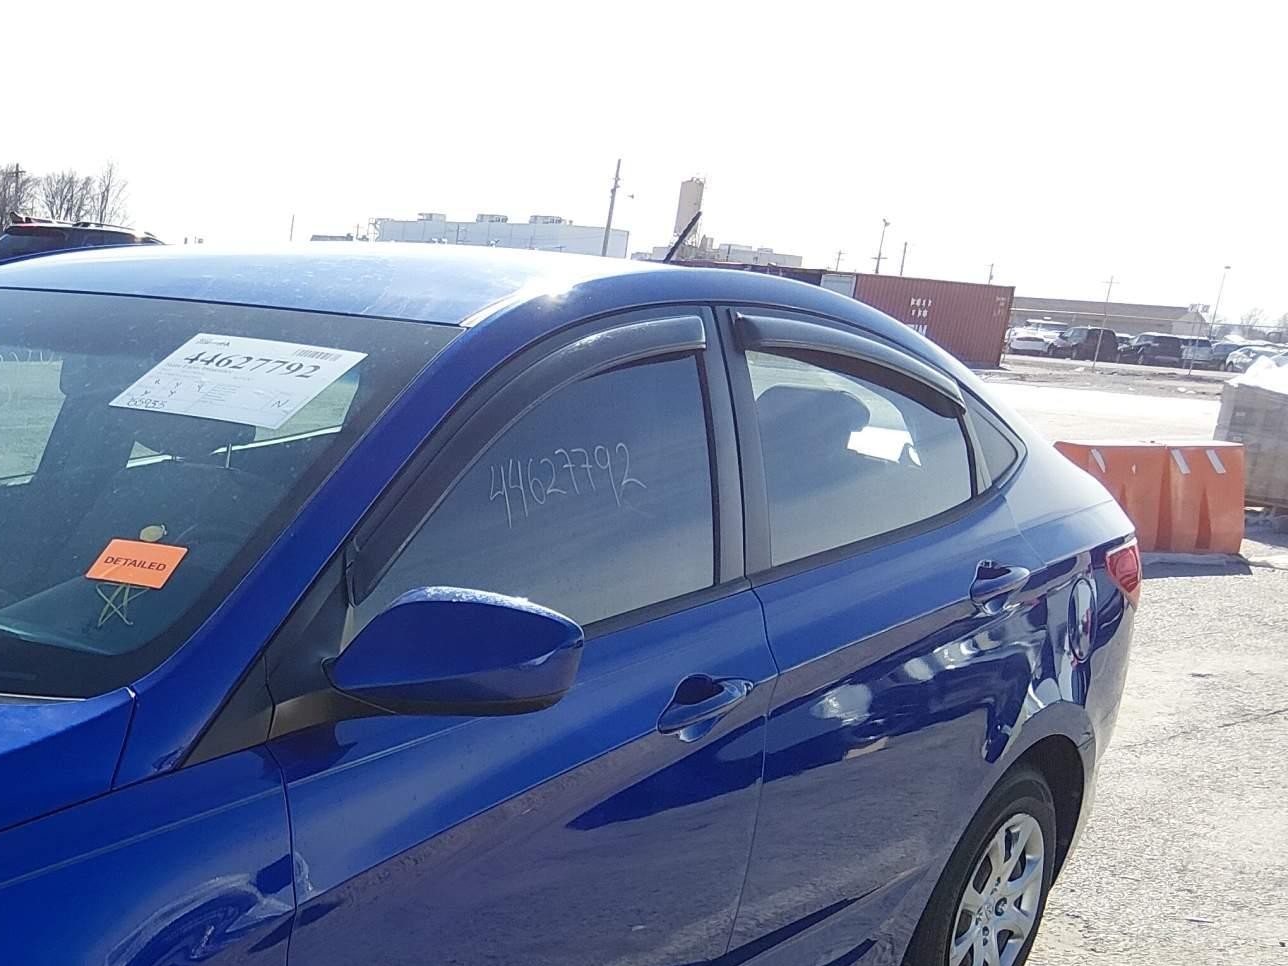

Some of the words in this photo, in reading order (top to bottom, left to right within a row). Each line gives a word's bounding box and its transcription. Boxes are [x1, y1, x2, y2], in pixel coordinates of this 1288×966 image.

[183, 351, 321, 379] 44627792
[489, 442, 647, 528] 44627792
[103, 555, 167, 572] DETAILED
